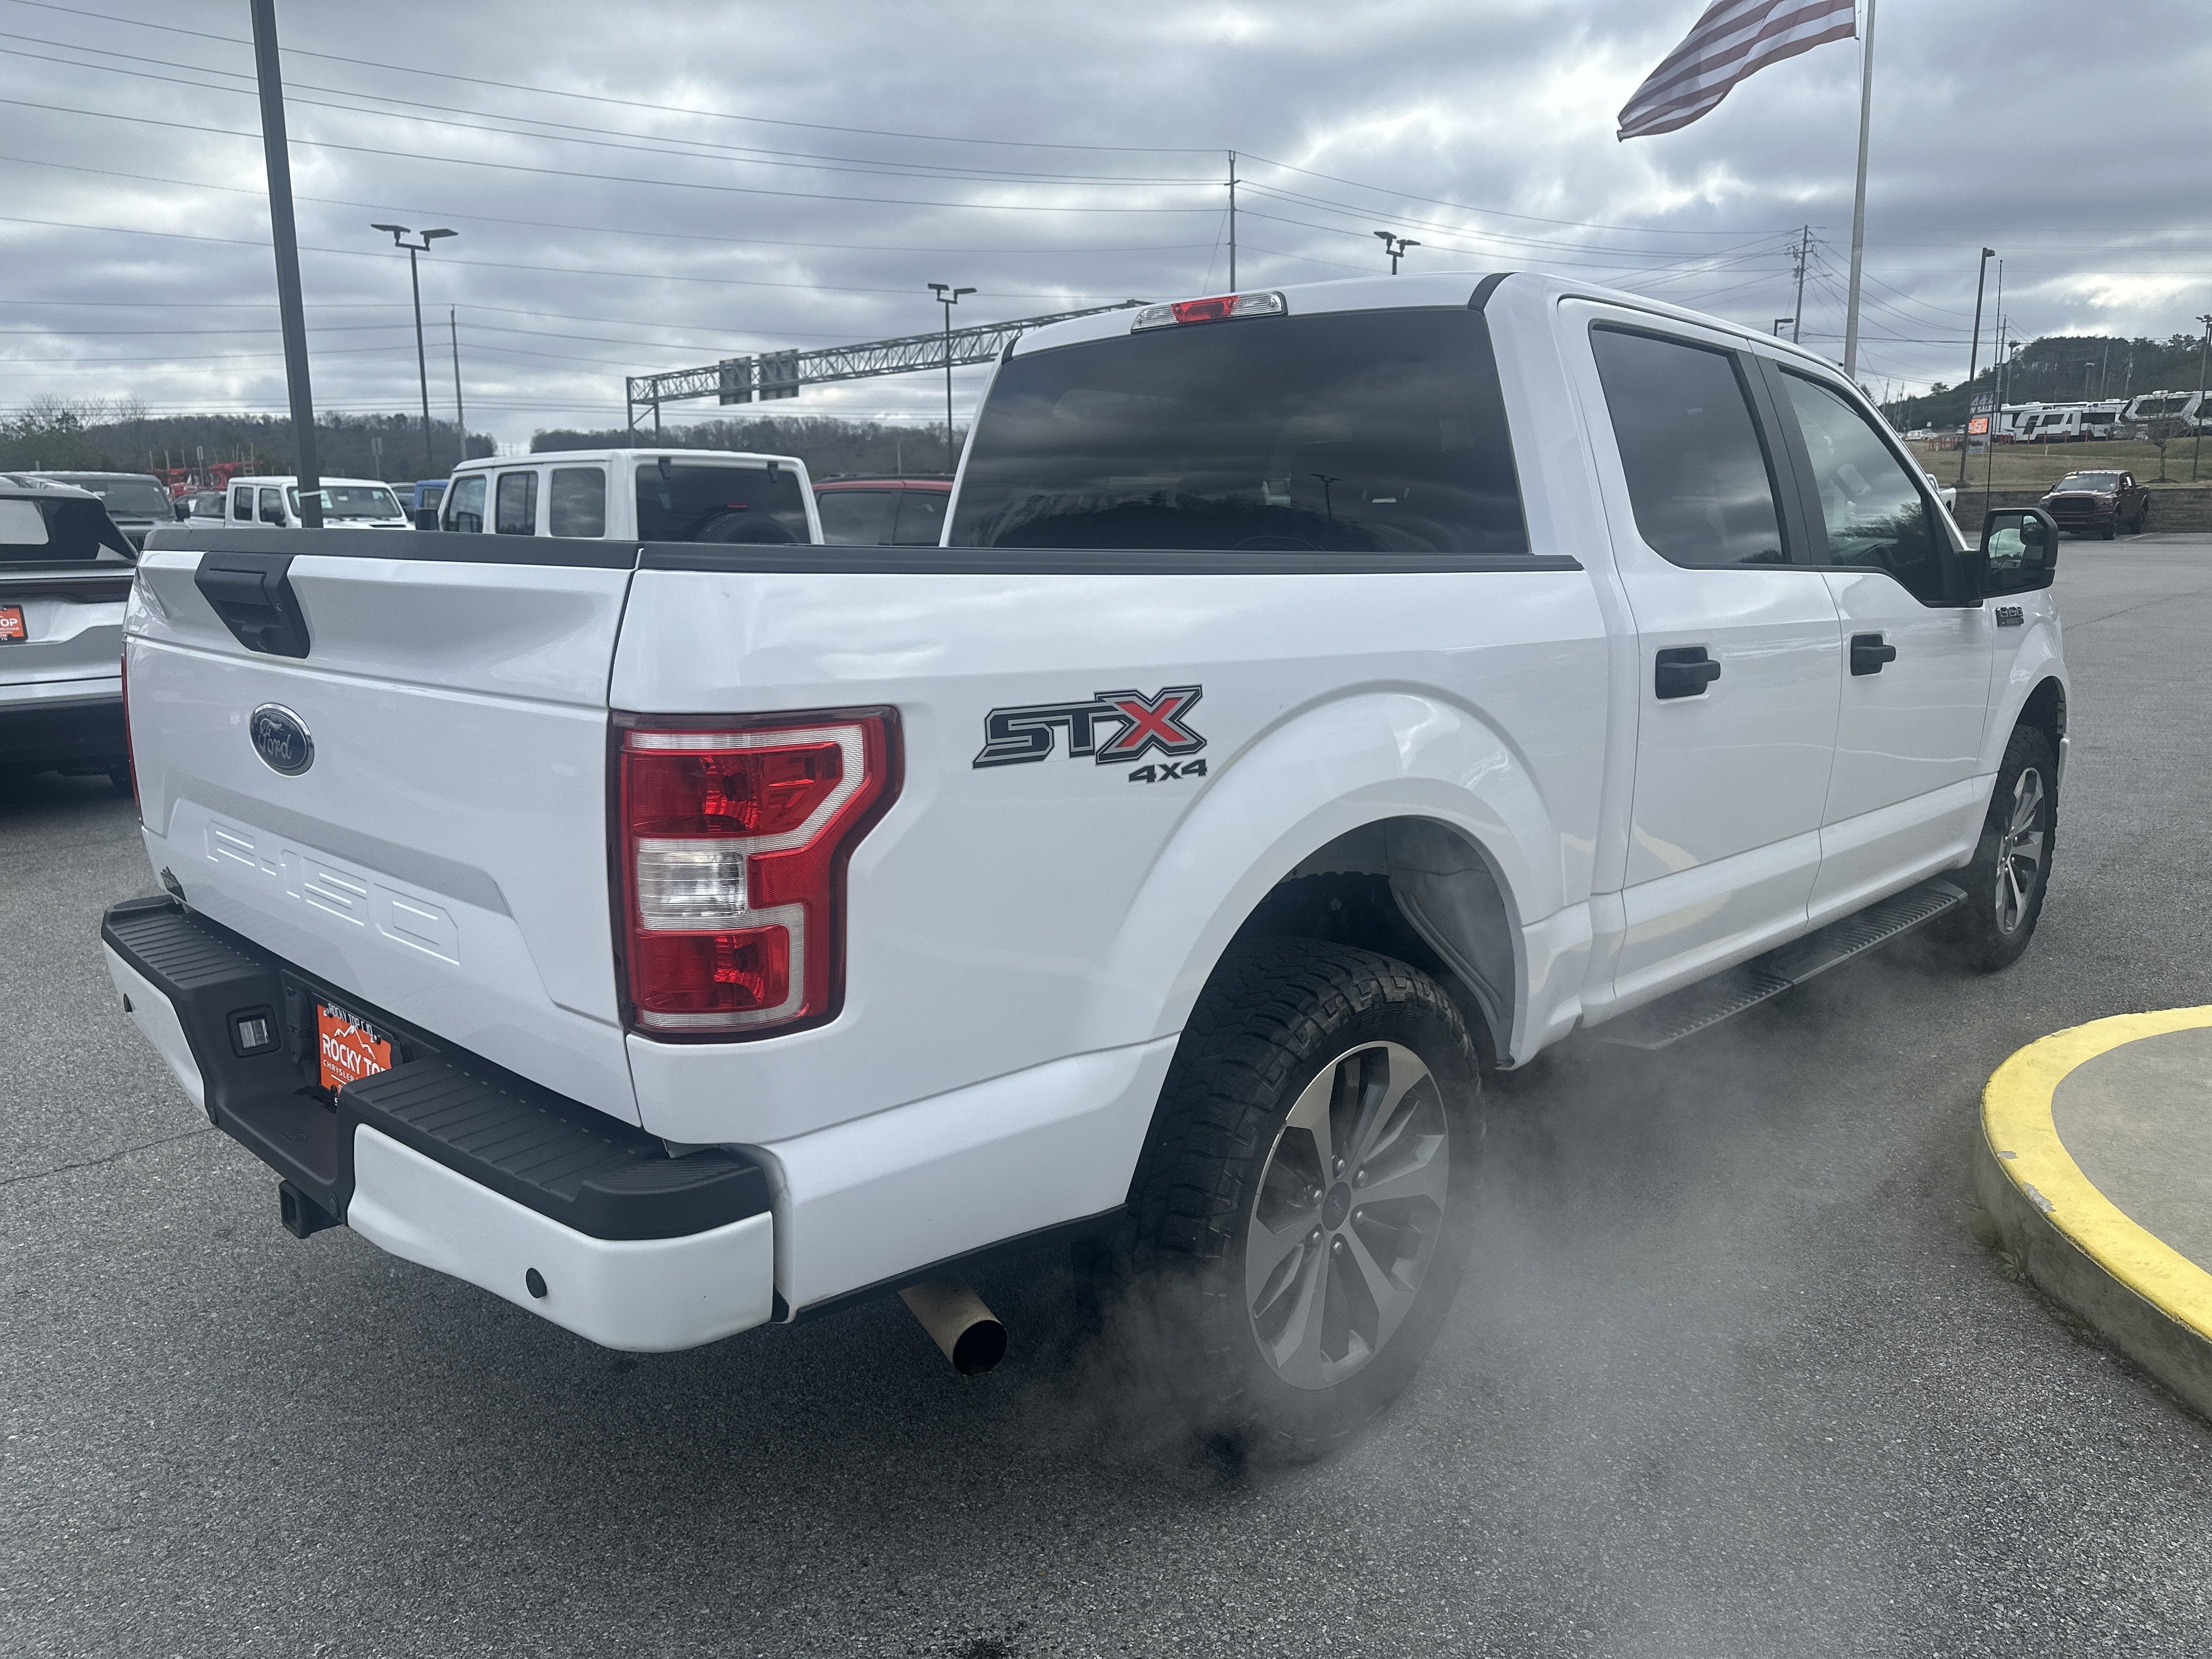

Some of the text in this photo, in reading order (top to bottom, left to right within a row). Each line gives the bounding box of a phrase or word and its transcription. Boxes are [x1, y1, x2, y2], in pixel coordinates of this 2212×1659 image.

[258, 717, 292, 760] Ford
[972, 684, 1207, 770] STX
[204, 820, 460, 966] F-150
[328, 1002, 347, 1023] ROCKY
[347, 1013, 360, 1029] TOP
[321, 1032, 387, 1076] ROCKY TO
[323, 1059, 354, 1081] CHRYSLER
